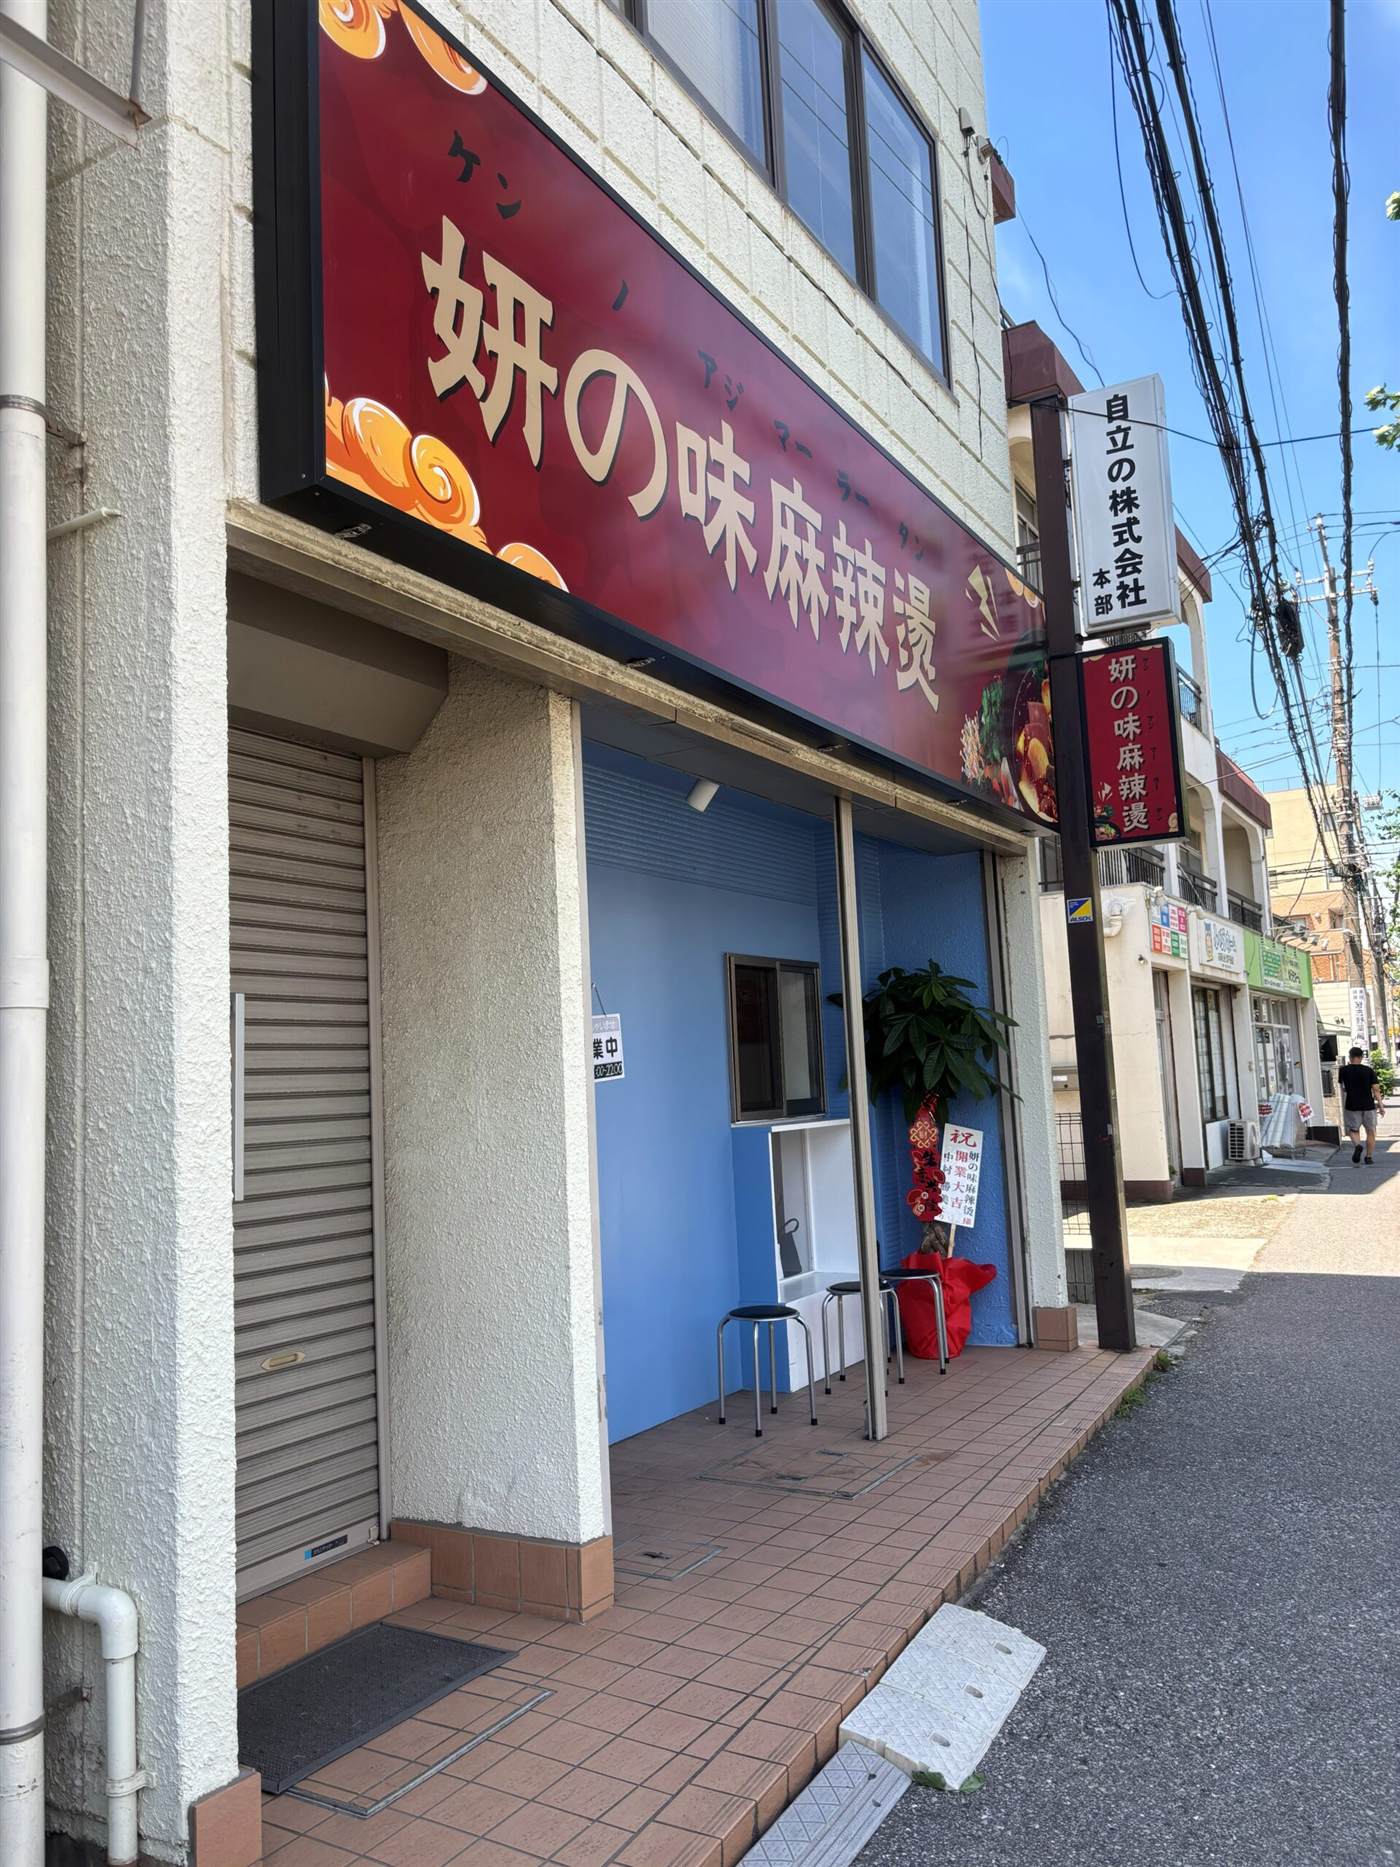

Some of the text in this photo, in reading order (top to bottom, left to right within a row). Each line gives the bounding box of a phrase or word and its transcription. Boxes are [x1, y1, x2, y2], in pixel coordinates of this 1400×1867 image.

[1105, 393, 1148, 610] 自立の株式会社
[1092, 568, 1114, 617] 本部
[949, 1129, 977, 1149] 祝
[951, 1150, 969, 1210] 開業大吉
